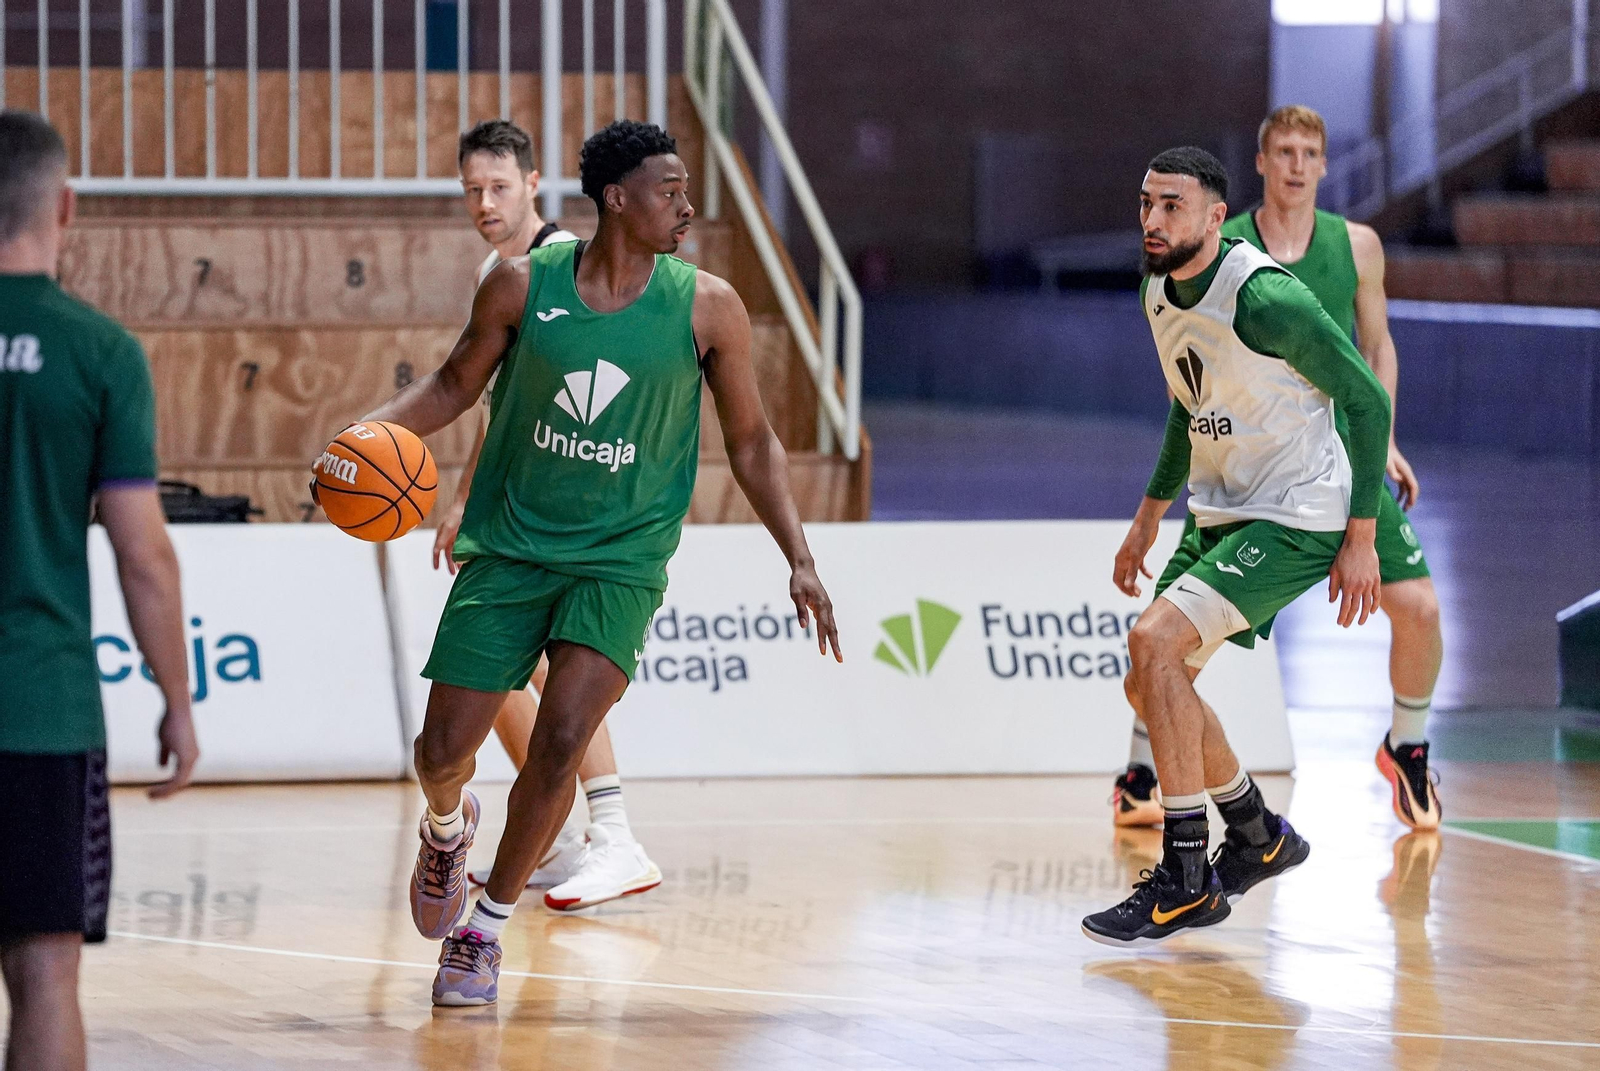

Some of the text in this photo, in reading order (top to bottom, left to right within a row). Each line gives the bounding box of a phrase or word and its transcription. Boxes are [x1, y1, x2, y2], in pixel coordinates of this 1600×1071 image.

[194, 258, 365, 288] 7 8
[241, 362, 259, 391] 7
[533, 419, 636, 473] Unicaja
[648, 605, 811, 641] dación
[93, 617, 260, 702] cja
[634, 646, 747, 692] icaja
